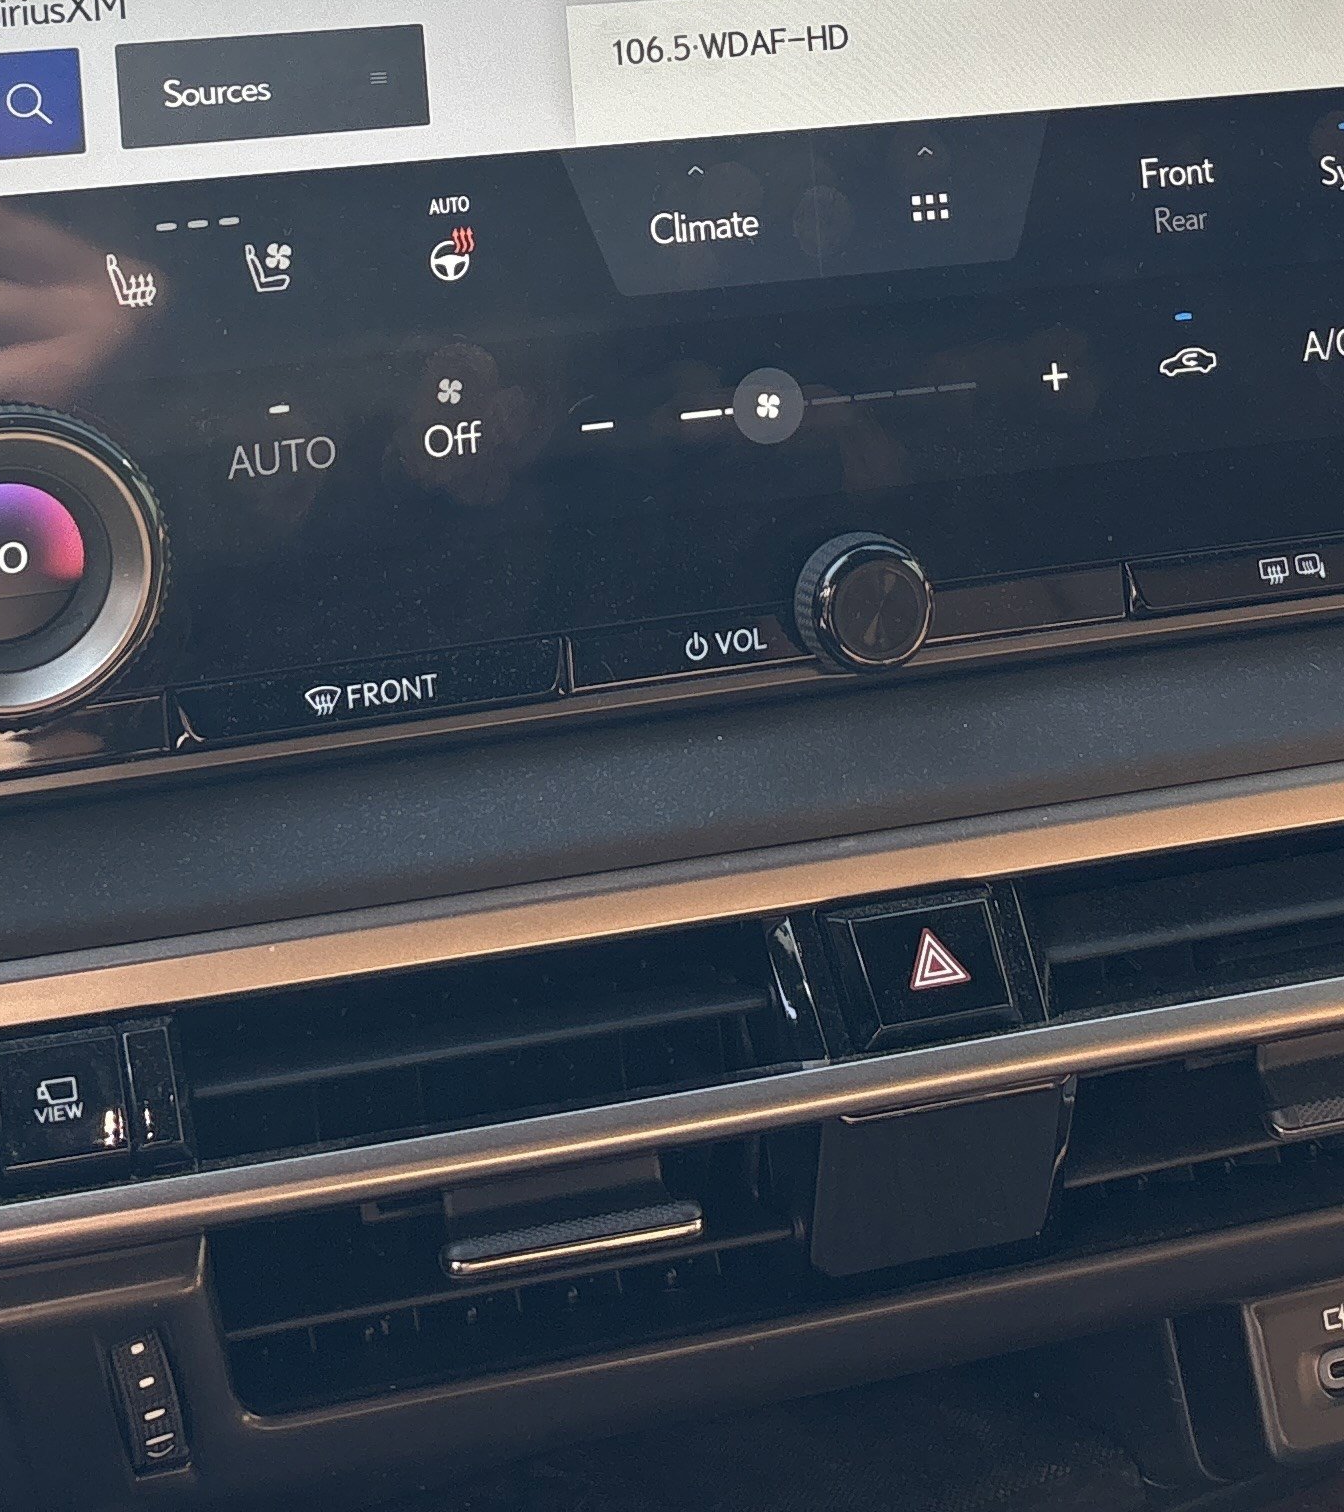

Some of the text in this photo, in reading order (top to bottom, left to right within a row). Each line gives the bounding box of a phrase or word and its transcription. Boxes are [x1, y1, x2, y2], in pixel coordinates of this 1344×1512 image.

[163, 79, 272, 108] Sources
[1140, 157, 1215, 189] Front
[429, 195, 470, 215] AUTO
[1154, 206, 1207, 234] Rear
[650, 211, 759, 245] Climate
[424, 420, 482, 458] Off
[228, 436, 336, 480] AUTO
[714, 627, 767, 655] VOL
[346, 673, 437, 709] FRONT
[34, 1102, 83, 1124] VIEW
